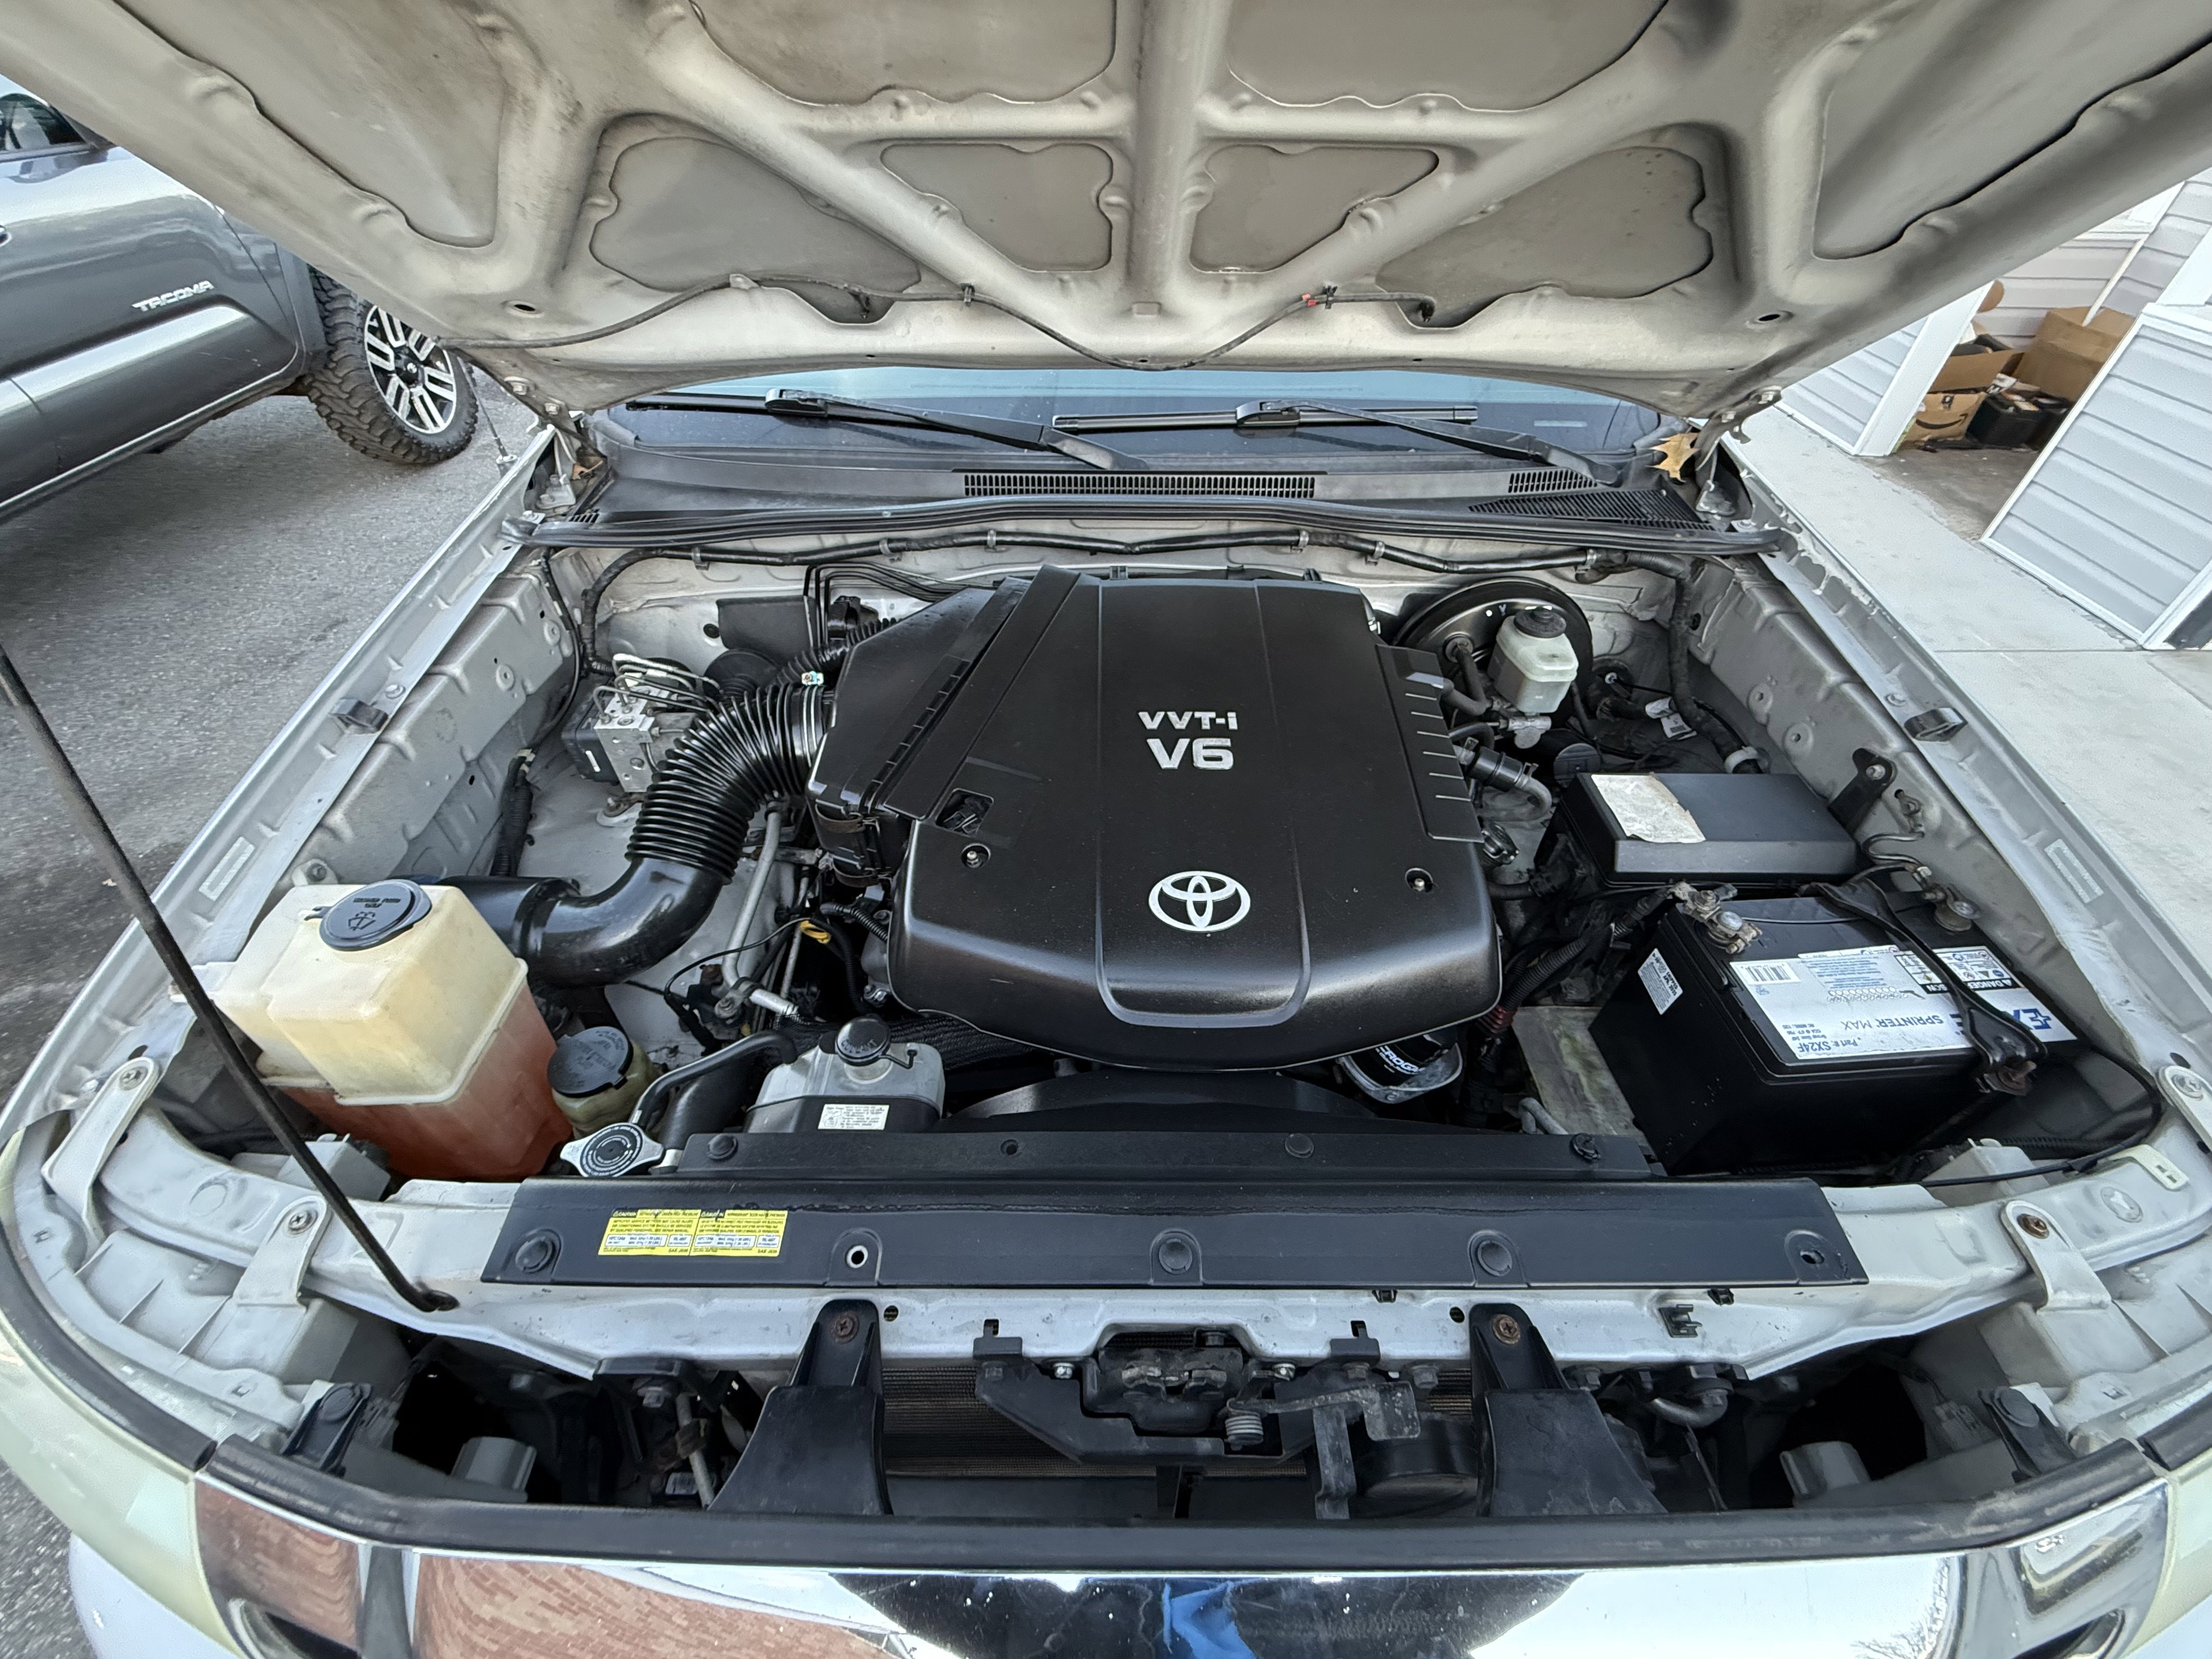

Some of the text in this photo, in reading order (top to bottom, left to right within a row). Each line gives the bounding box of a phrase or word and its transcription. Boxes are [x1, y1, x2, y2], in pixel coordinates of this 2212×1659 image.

[132, 280, 215, 312] TACOMA
[1146, 737, 1234, 770] V6
[1841, 1019, 1872, 1030] MAX
[1797, 1041, 1831, 1052] SX24F
